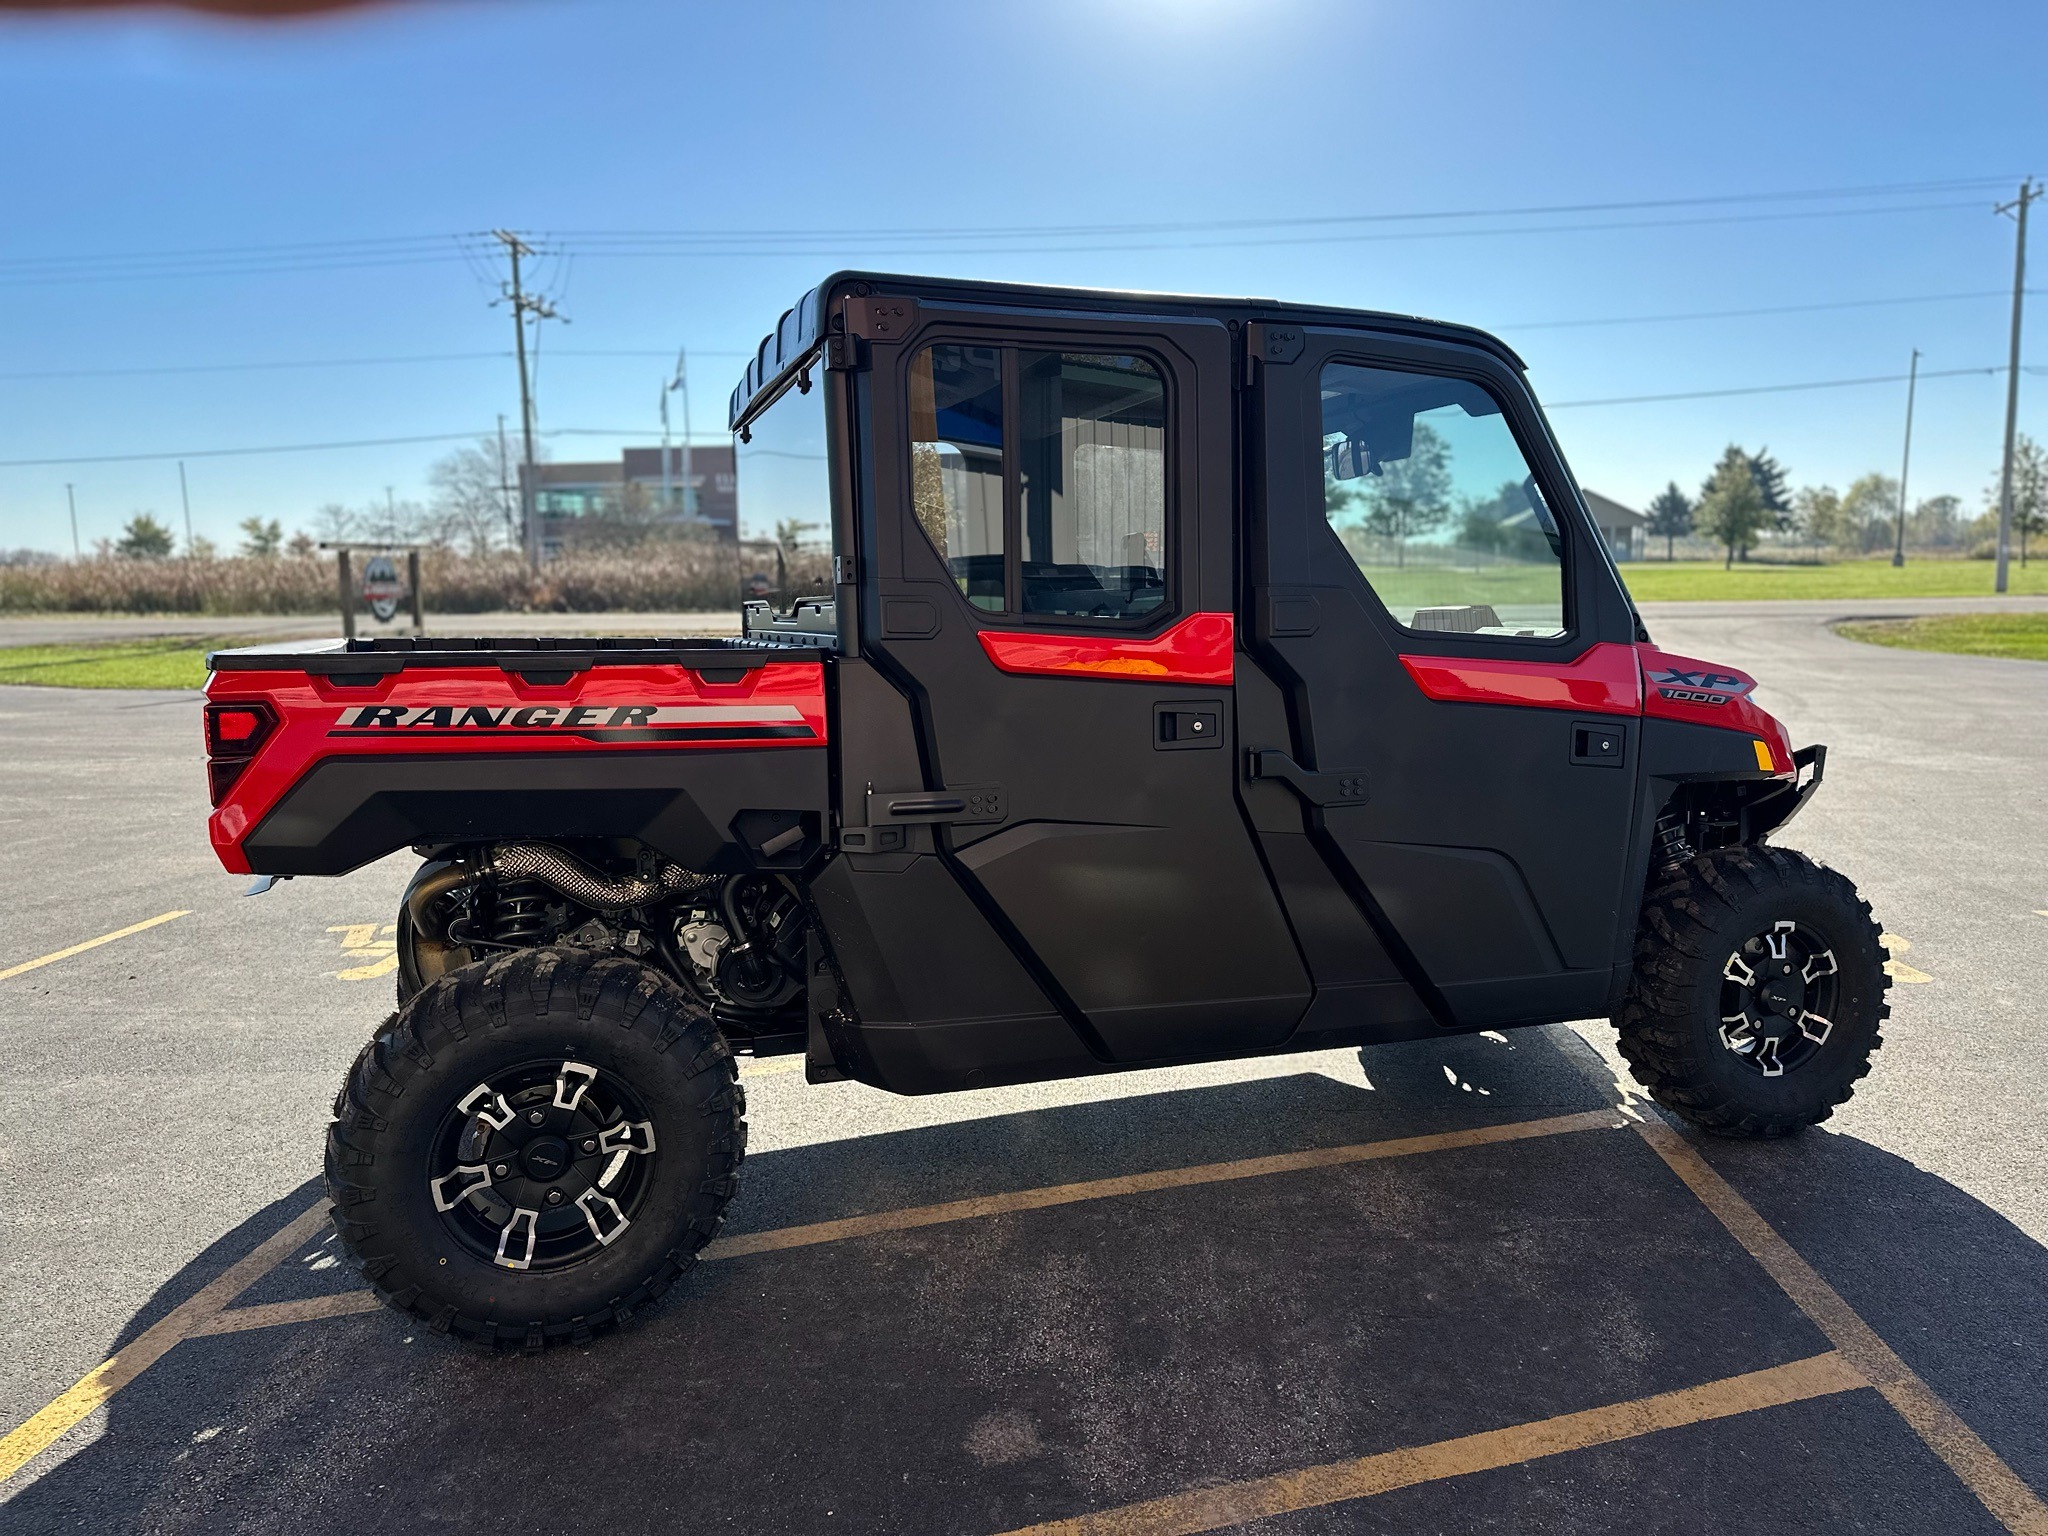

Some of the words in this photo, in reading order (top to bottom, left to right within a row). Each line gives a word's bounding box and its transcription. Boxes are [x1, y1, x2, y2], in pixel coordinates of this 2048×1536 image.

[1656, 667, 1741, 688] XP
[1666, 689, 1726, 704] 1000
[350, 706, 658, 729] RANGER
[531, 1155, 558, 1166] XP
